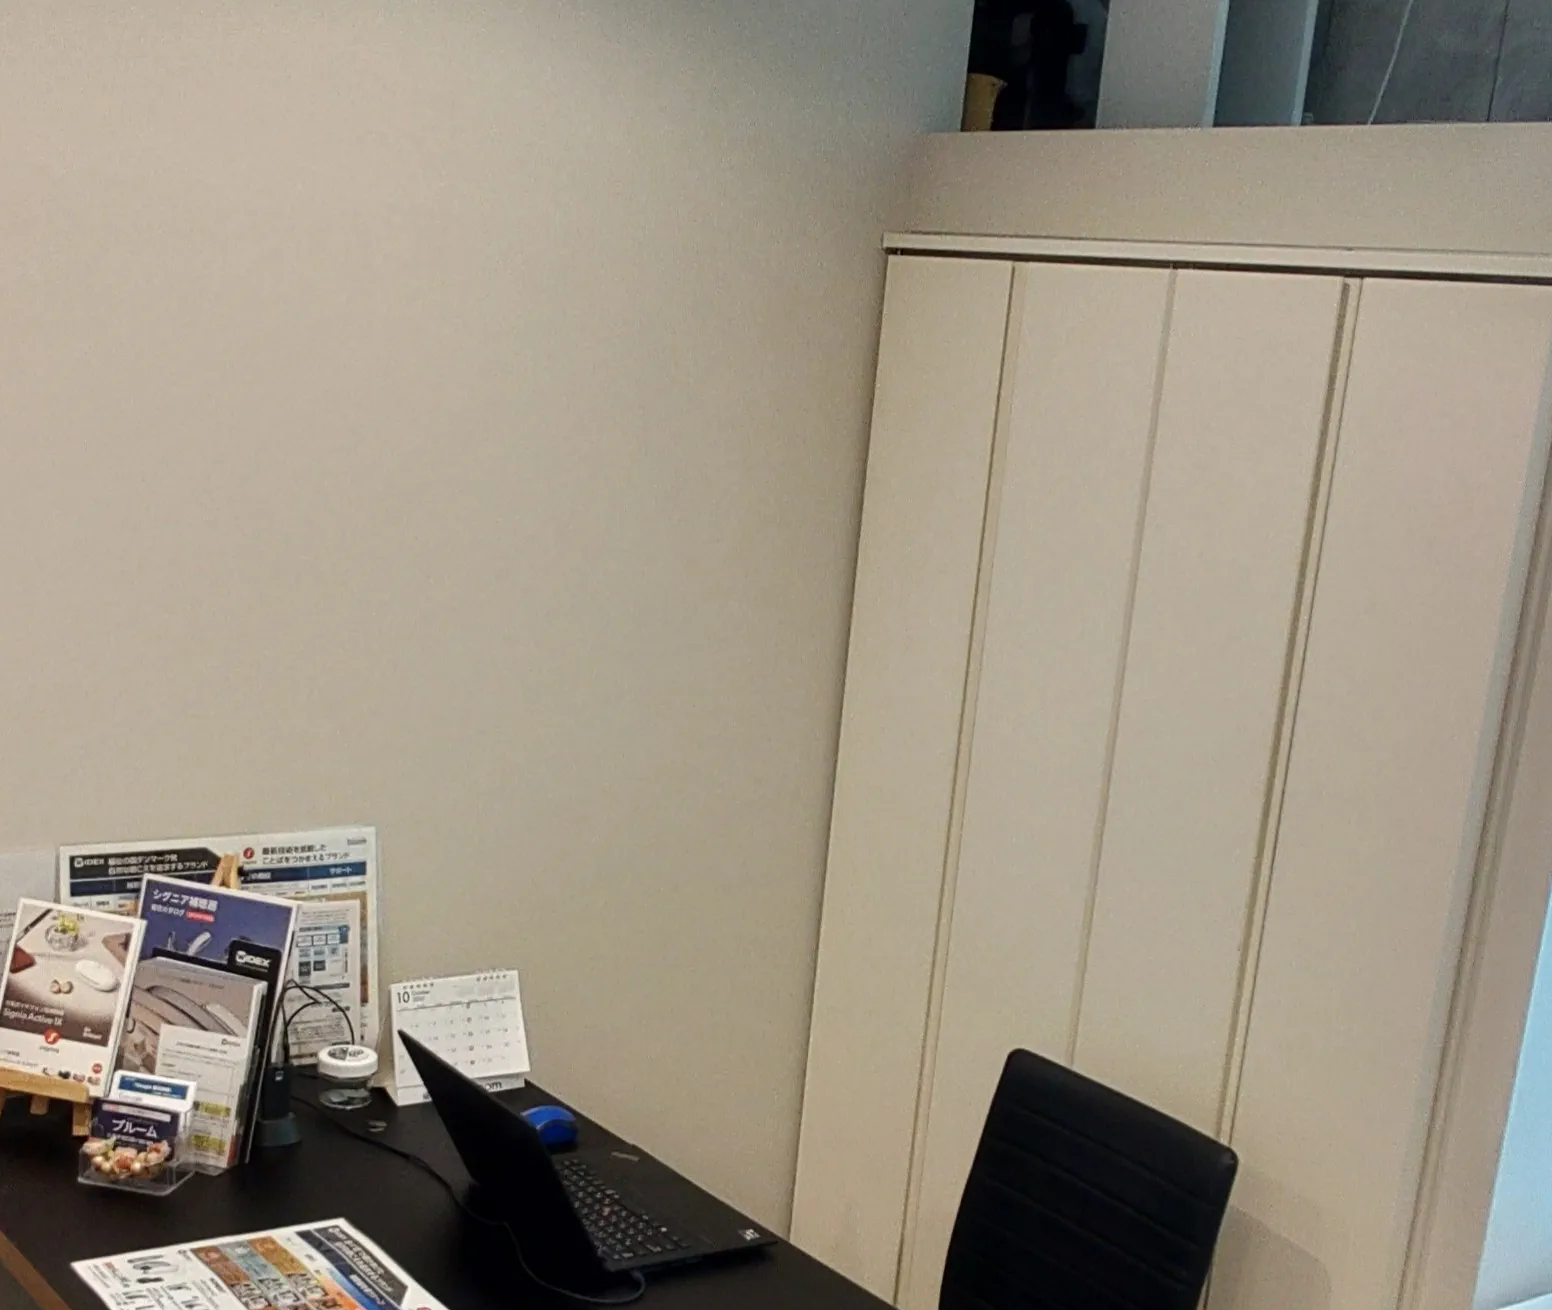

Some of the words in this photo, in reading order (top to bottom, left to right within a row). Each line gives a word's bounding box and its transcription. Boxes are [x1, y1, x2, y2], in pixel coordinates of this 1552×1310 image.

[153, 889, 218, 912] シグニア補聴器
[397, 990, 410, 1004] 10
[3, 1007, 28, 1020] Signia
[112, 1119, 157, 1138] ブルーム
